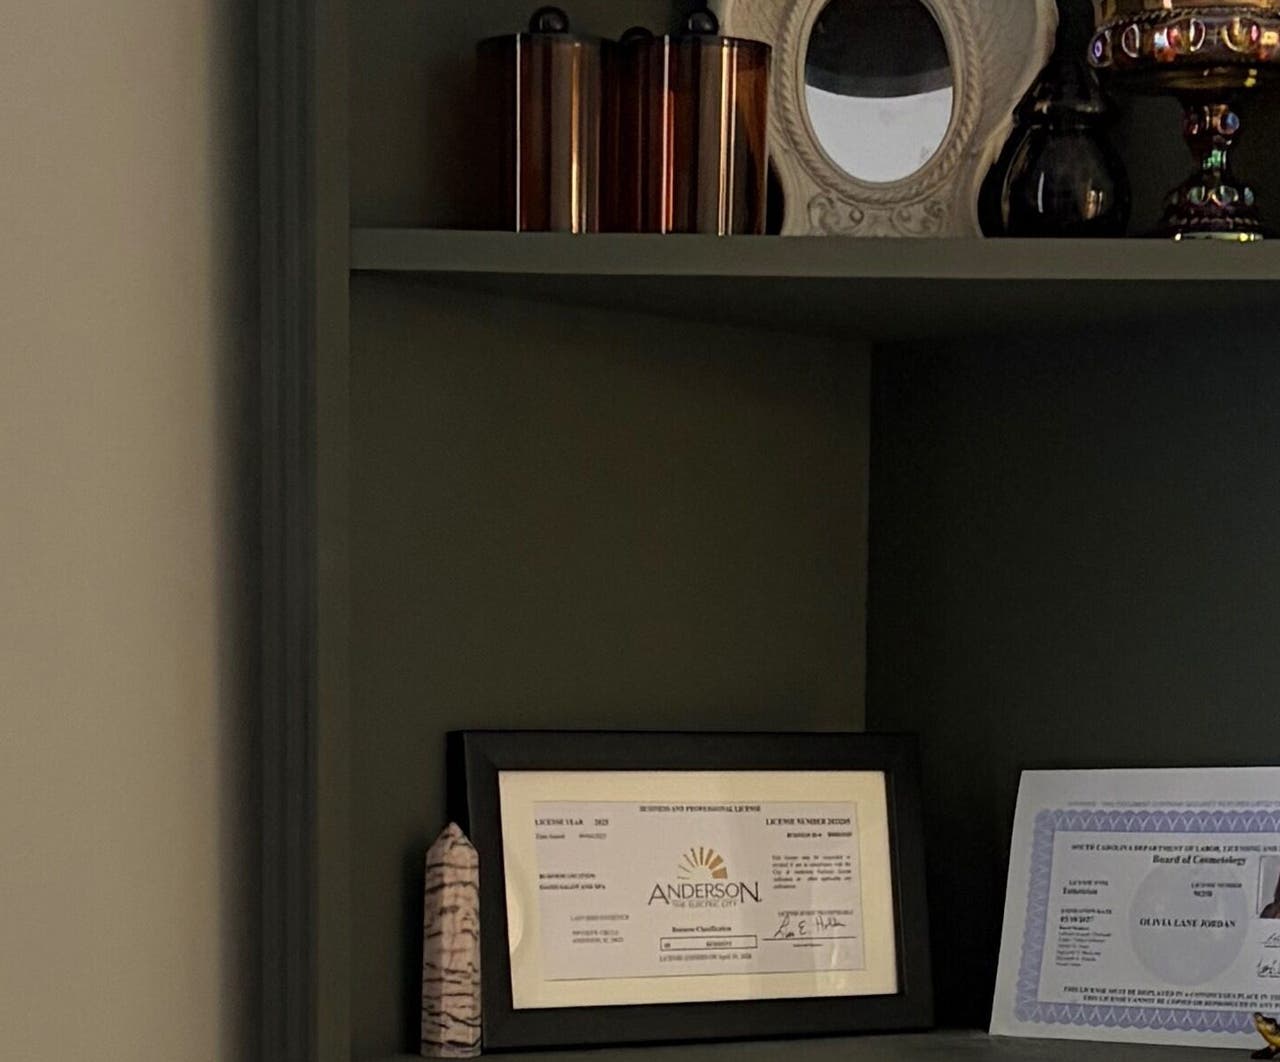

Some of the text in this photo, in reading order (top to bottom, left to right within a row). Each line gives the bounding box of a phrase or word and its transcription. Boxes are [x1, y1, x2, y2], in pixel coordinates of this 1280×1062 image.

[686, 805, 733, 813] PROFESSIONAL
[734, 805, 761, 813] LICENSE
[534, 818, 564, 826] LICENSE
[565, 818, 584, 826] YEAR
[765, 817, 795, 826] LICENSE
[796, 817, 826, 826] NUMBER
[1152, 854, 1248, 867] Board of Cosmetology
[648, 881, 761, 905] ANDERSON
[1139, 918, 1236, 928] OLIVIA LANE JORDAN
